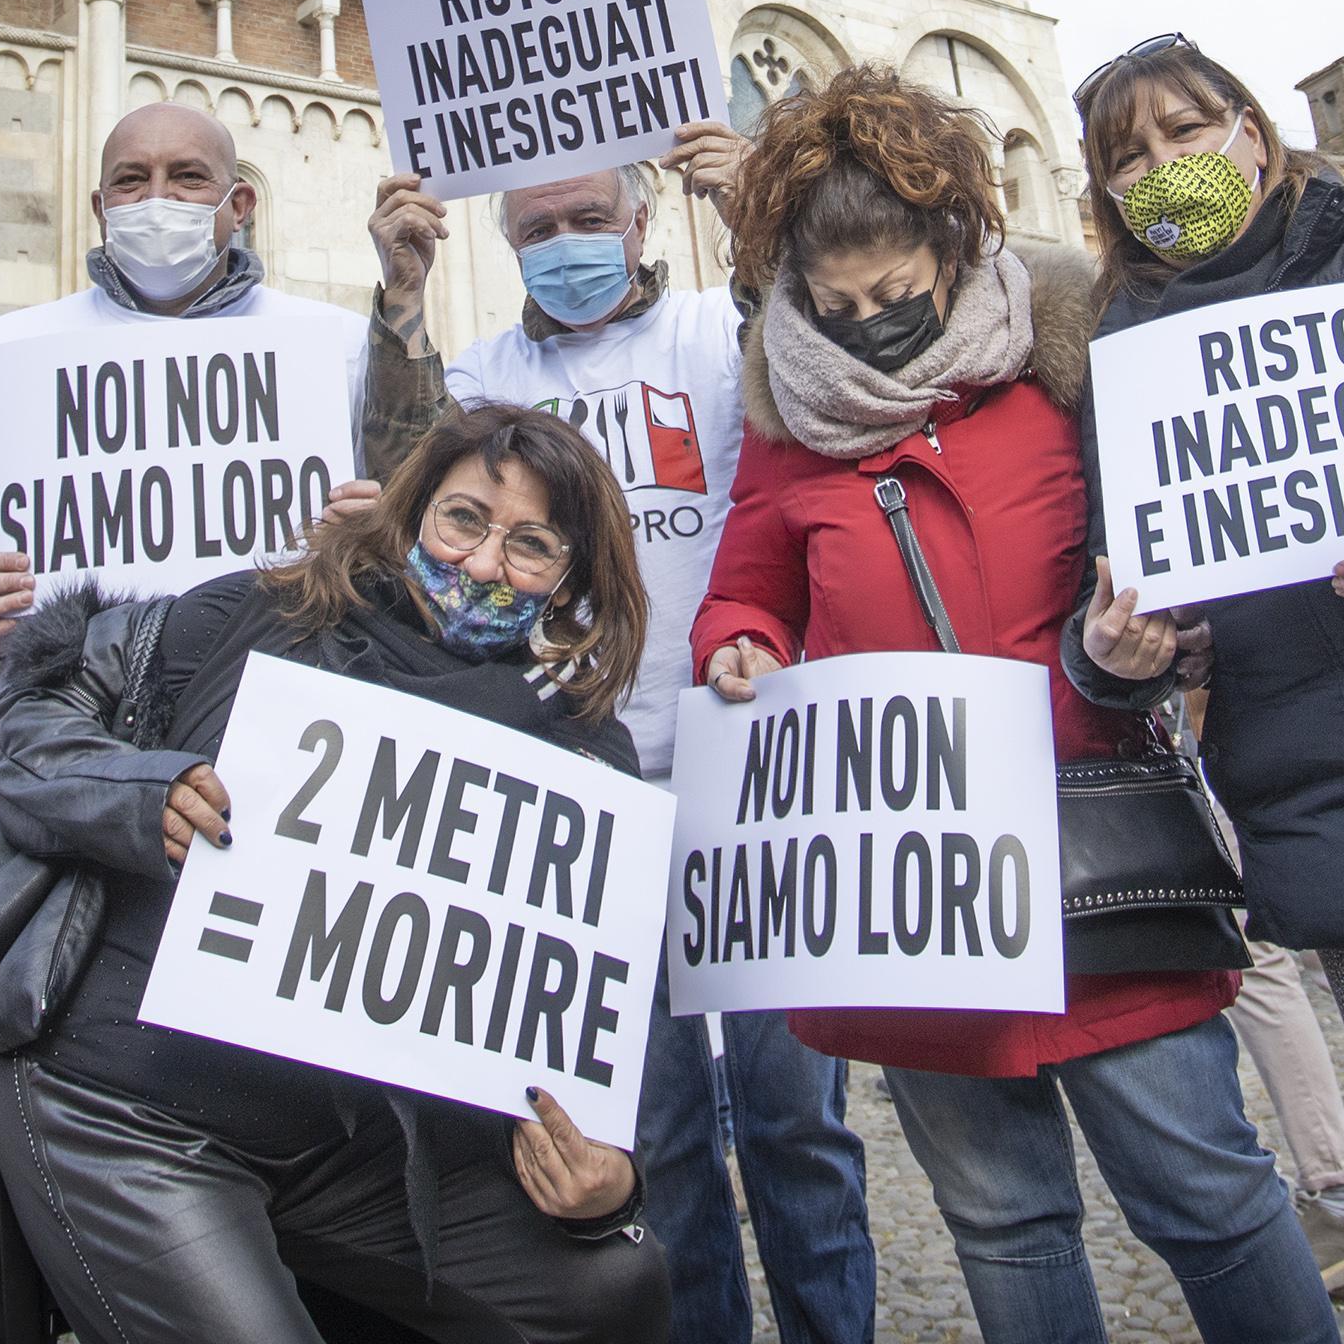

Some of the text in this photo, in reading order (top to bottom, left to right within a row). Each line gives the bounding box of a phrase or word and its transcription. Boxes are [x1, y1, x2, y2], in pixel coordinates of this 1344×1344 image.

[403, 58, 710, 179] E INESISTENTI
[56, 351, 279, 459] NOI NON
[0, 455, 331, 575] SIAMO LORO
[1134, 500, 1171, 577] E
[736, 695, 966, 825] NOI NON
[274, 719, 615, 927] 2 METRI
[683, 830, 1030, 967] SIAMO LORO
[197, 869, 629, 1088] = MORIRE
